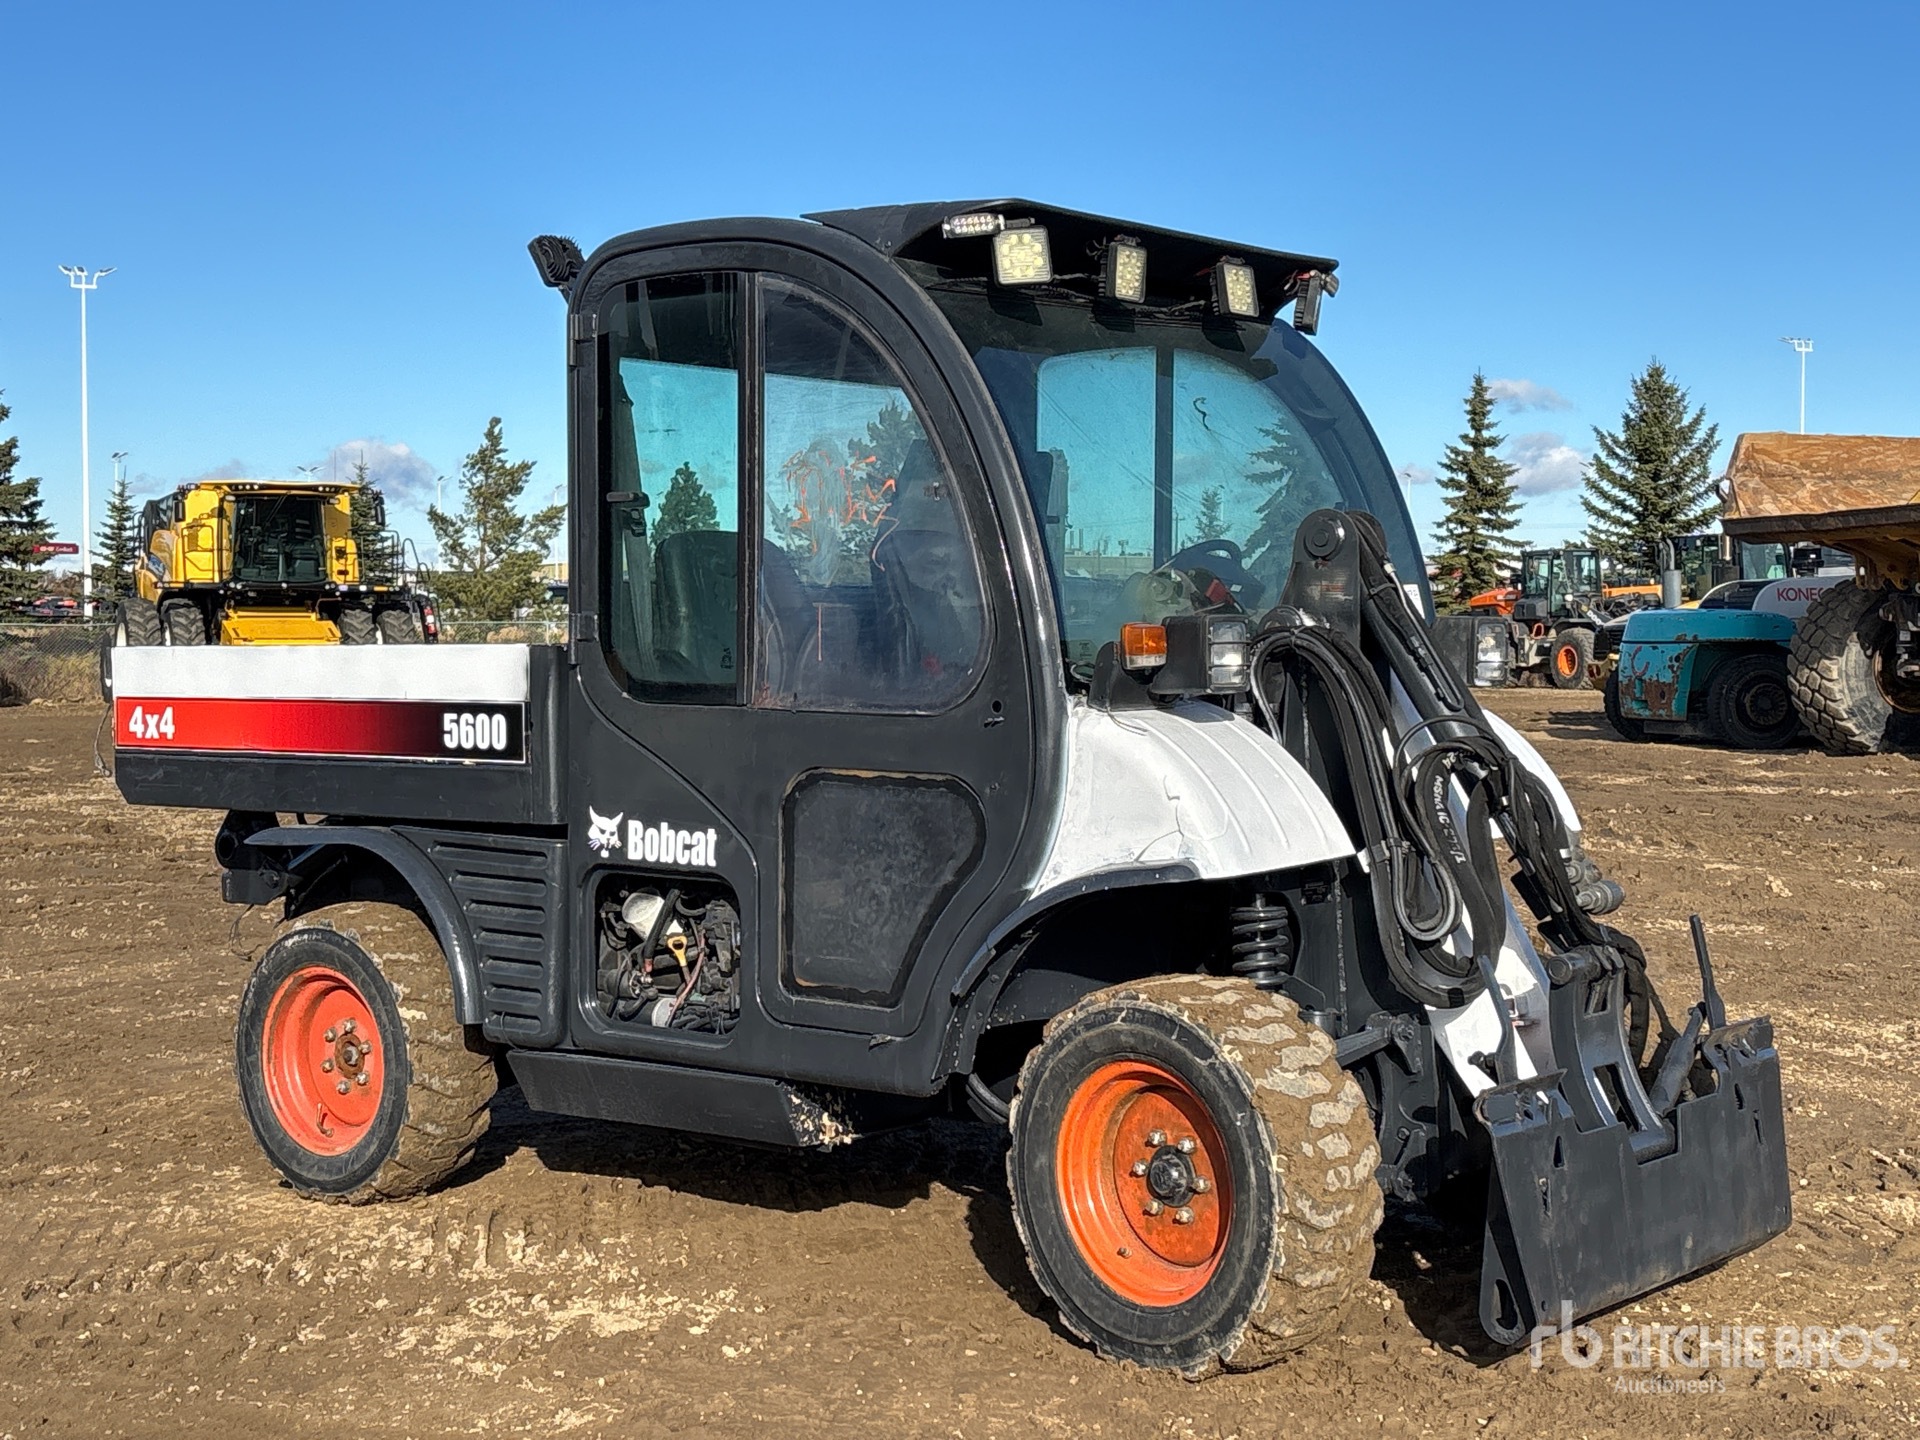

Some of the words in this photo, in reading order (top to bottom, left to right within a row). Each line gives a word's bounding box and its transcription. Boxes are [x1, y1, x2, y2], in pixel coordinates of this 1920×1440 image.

[129, 706, 175, 740] 4x4
[443, 712, 507, 750] 5600
[627, 819, 717, 867] Bobcat
